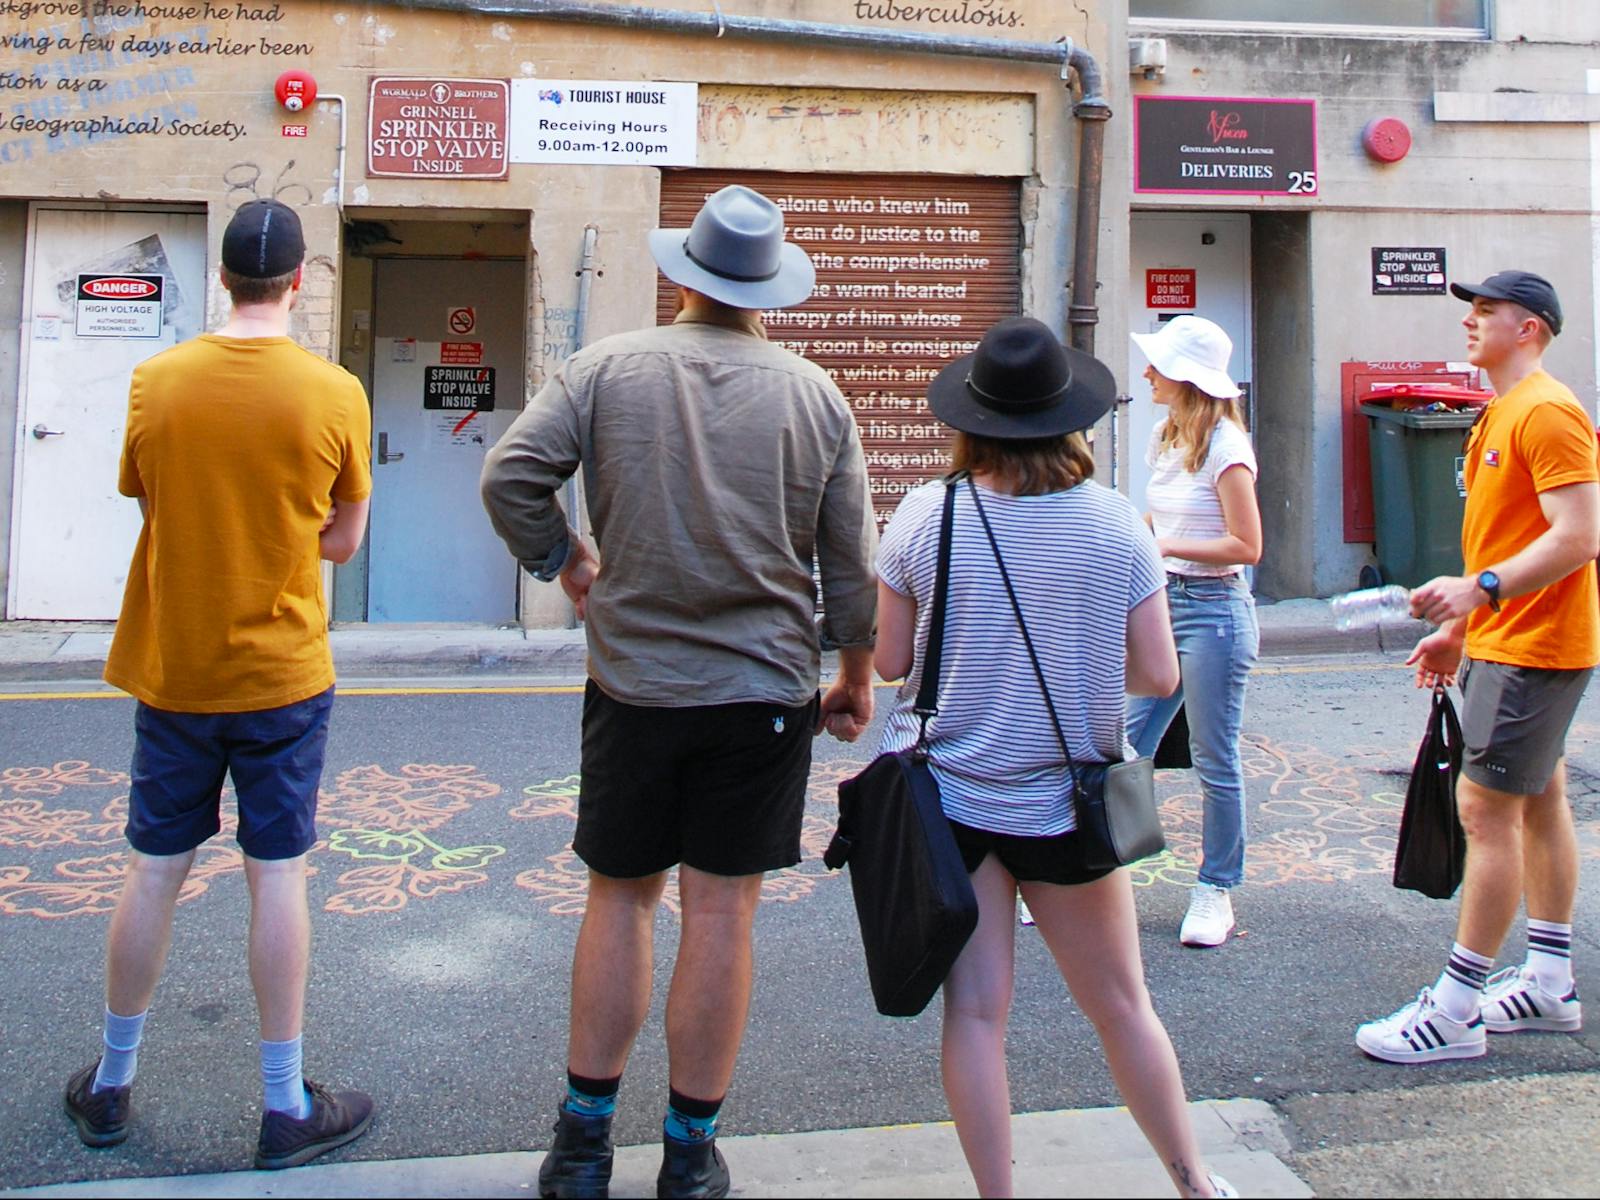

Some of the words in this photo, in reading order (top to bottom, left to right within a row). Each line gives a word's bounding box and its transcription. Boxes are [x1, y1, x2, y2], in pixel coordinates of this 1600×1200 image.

[93, 0, 130, 17] the
[134, 0, 202, 20] house
[203, 3, 234, 20] he
[236, 4, 285, 22] had
[57, 37, 77, 49] a
[79, 32, 114, 54] few
[121, 35, 175, 58] days
[178, 38, 256, 56] earlier
[259, 38, 314, 56] been
[57, 77, 86, 92] as
[88, 78, 108, 92] a
[381, 88, 427, 98] WORMALD
[454, 90, 499, 99] BROTHERS
[569, 89, 622, 105] TOURIST
[626, 91, 667, 105] HOUSE
[400, 105, 477, 119] GRINNELL
[10, 114, 164, 140] Geographical
[167, 119, 248, 142] Society.
[284, 126, 306, 136] FIRE
[380, 119, 497, 140] SPRINKLER
[539, 119, 617, 136] Receiving
[622, 121, 668, 133] Hours
[373, 138, 428, 158] STOP
[435, 140, 504, 160] VALVE
[538, 139, 669, 155] 9.00am-12.00pm
[1247, 146, 1275, 155] LOUNGE
[412, 159, 463, 173] INSIDE
[1181, 162, 1274, 179] DELIVERIES
[1288, 171, 1317, 194] 25
[833, 196, 875, 214] who
[879, 196, 931, 215] knew
[935, 197, 970, 215] him
[793, 228, 827, 242] can
[831, 224, 856, 242] do
[859, 224, 920, 244] justice
[926, 225, 944, 242] to
[949, 225, 981, 243] the
[812, 252, 844, 269] the
[849, 253, 990, 273] comprehensive
[1382, 251, 1437, 261] SPRINKLER
[1379, 262, 1406, 272] STOP
[1411, 263, 1441, 272] VALVE
[1151, 274, 1168, 283] FIRE
[1169, 274, 1190, 283] DOOR
[1393, 274, 1426, 283] INSIDE
[92, 282, 148, 294] DANGER
[835, 284, 889, 298] warm
[893, 281, 967, 299] hearted
[1157, 285, 1168, 294] DO
[1169, 285, 1184, 294] NOT
[1151, 295, 1191, 304] OBSTRUCT
[110, 306, 153, 314] VOLTAGE
[836, 307, 857, 326] of
[860, 309, 896, 326] him
[899, 311, 962, 327] whose
[812, 341, 858, 354] soon
[863, 336, 888, 354] be
[843, 365, 900, 380] which
[430, 382, 457, 394] STOP
[459, 383, 491, 395] VALVE
[442, 395, 478, 408] INSIDE
[854, 391, 877, 409] of
[881, 391, 912, 409] the
[869, 420, 898, 438] his
